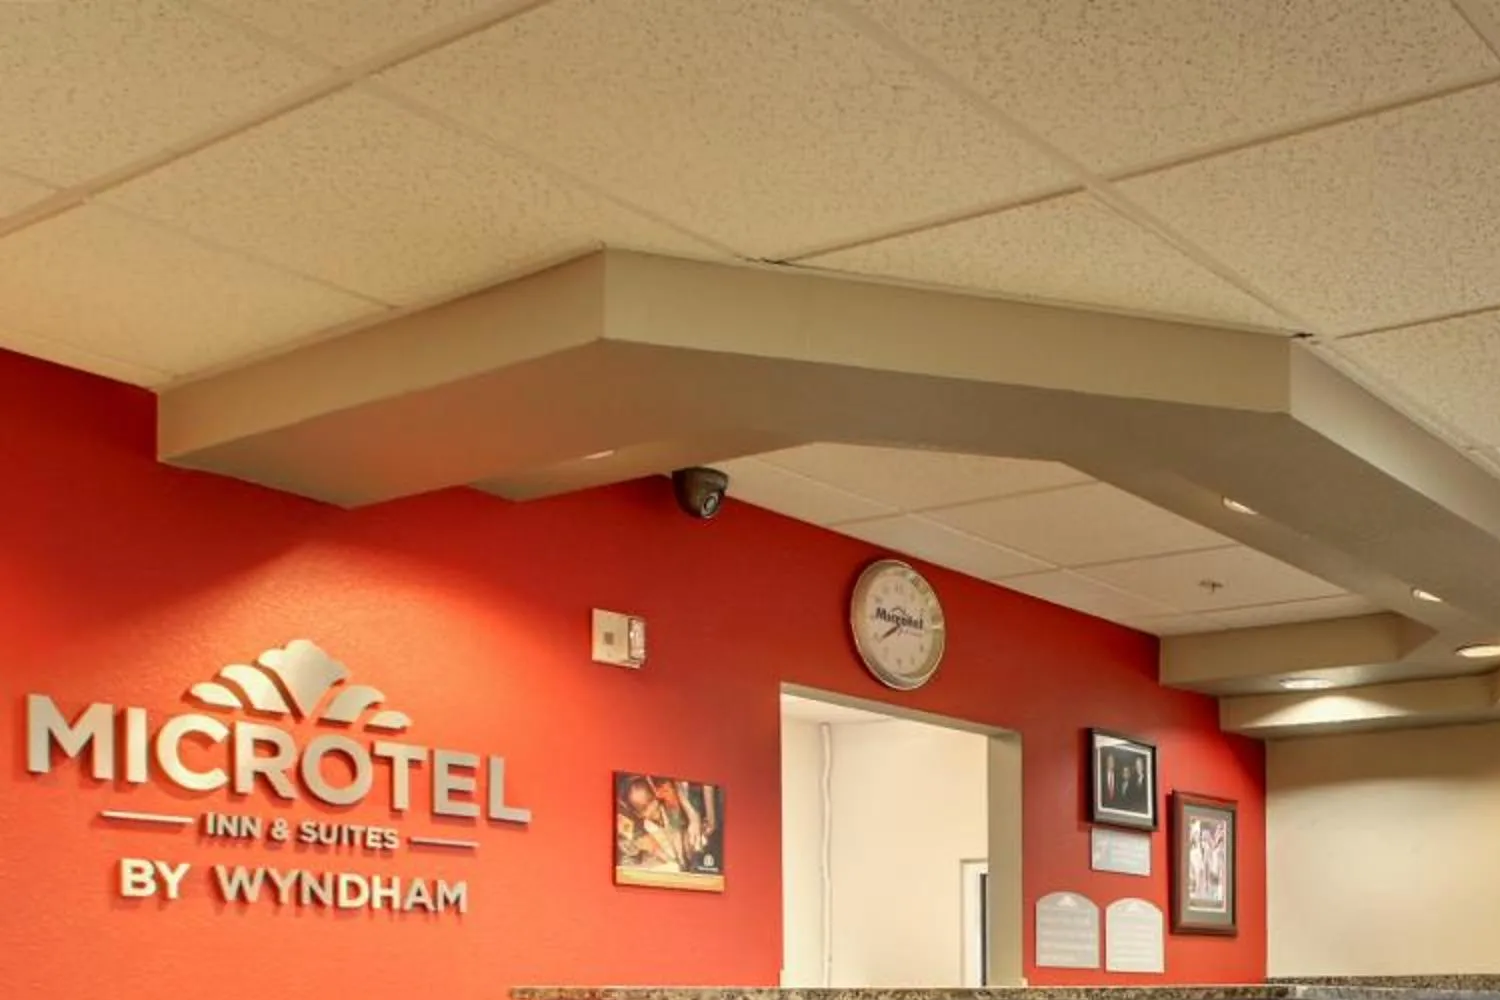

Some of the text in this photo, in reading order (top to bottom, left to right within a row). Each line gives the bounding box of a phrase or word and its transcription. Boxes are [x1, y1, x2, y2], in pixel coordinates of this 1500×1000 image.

[26, 693, 532, 823] MICROTEL
[207, 811, 400, 850] INN & SUITES
[120, 858, 469, 912] BY WYNDHAM
